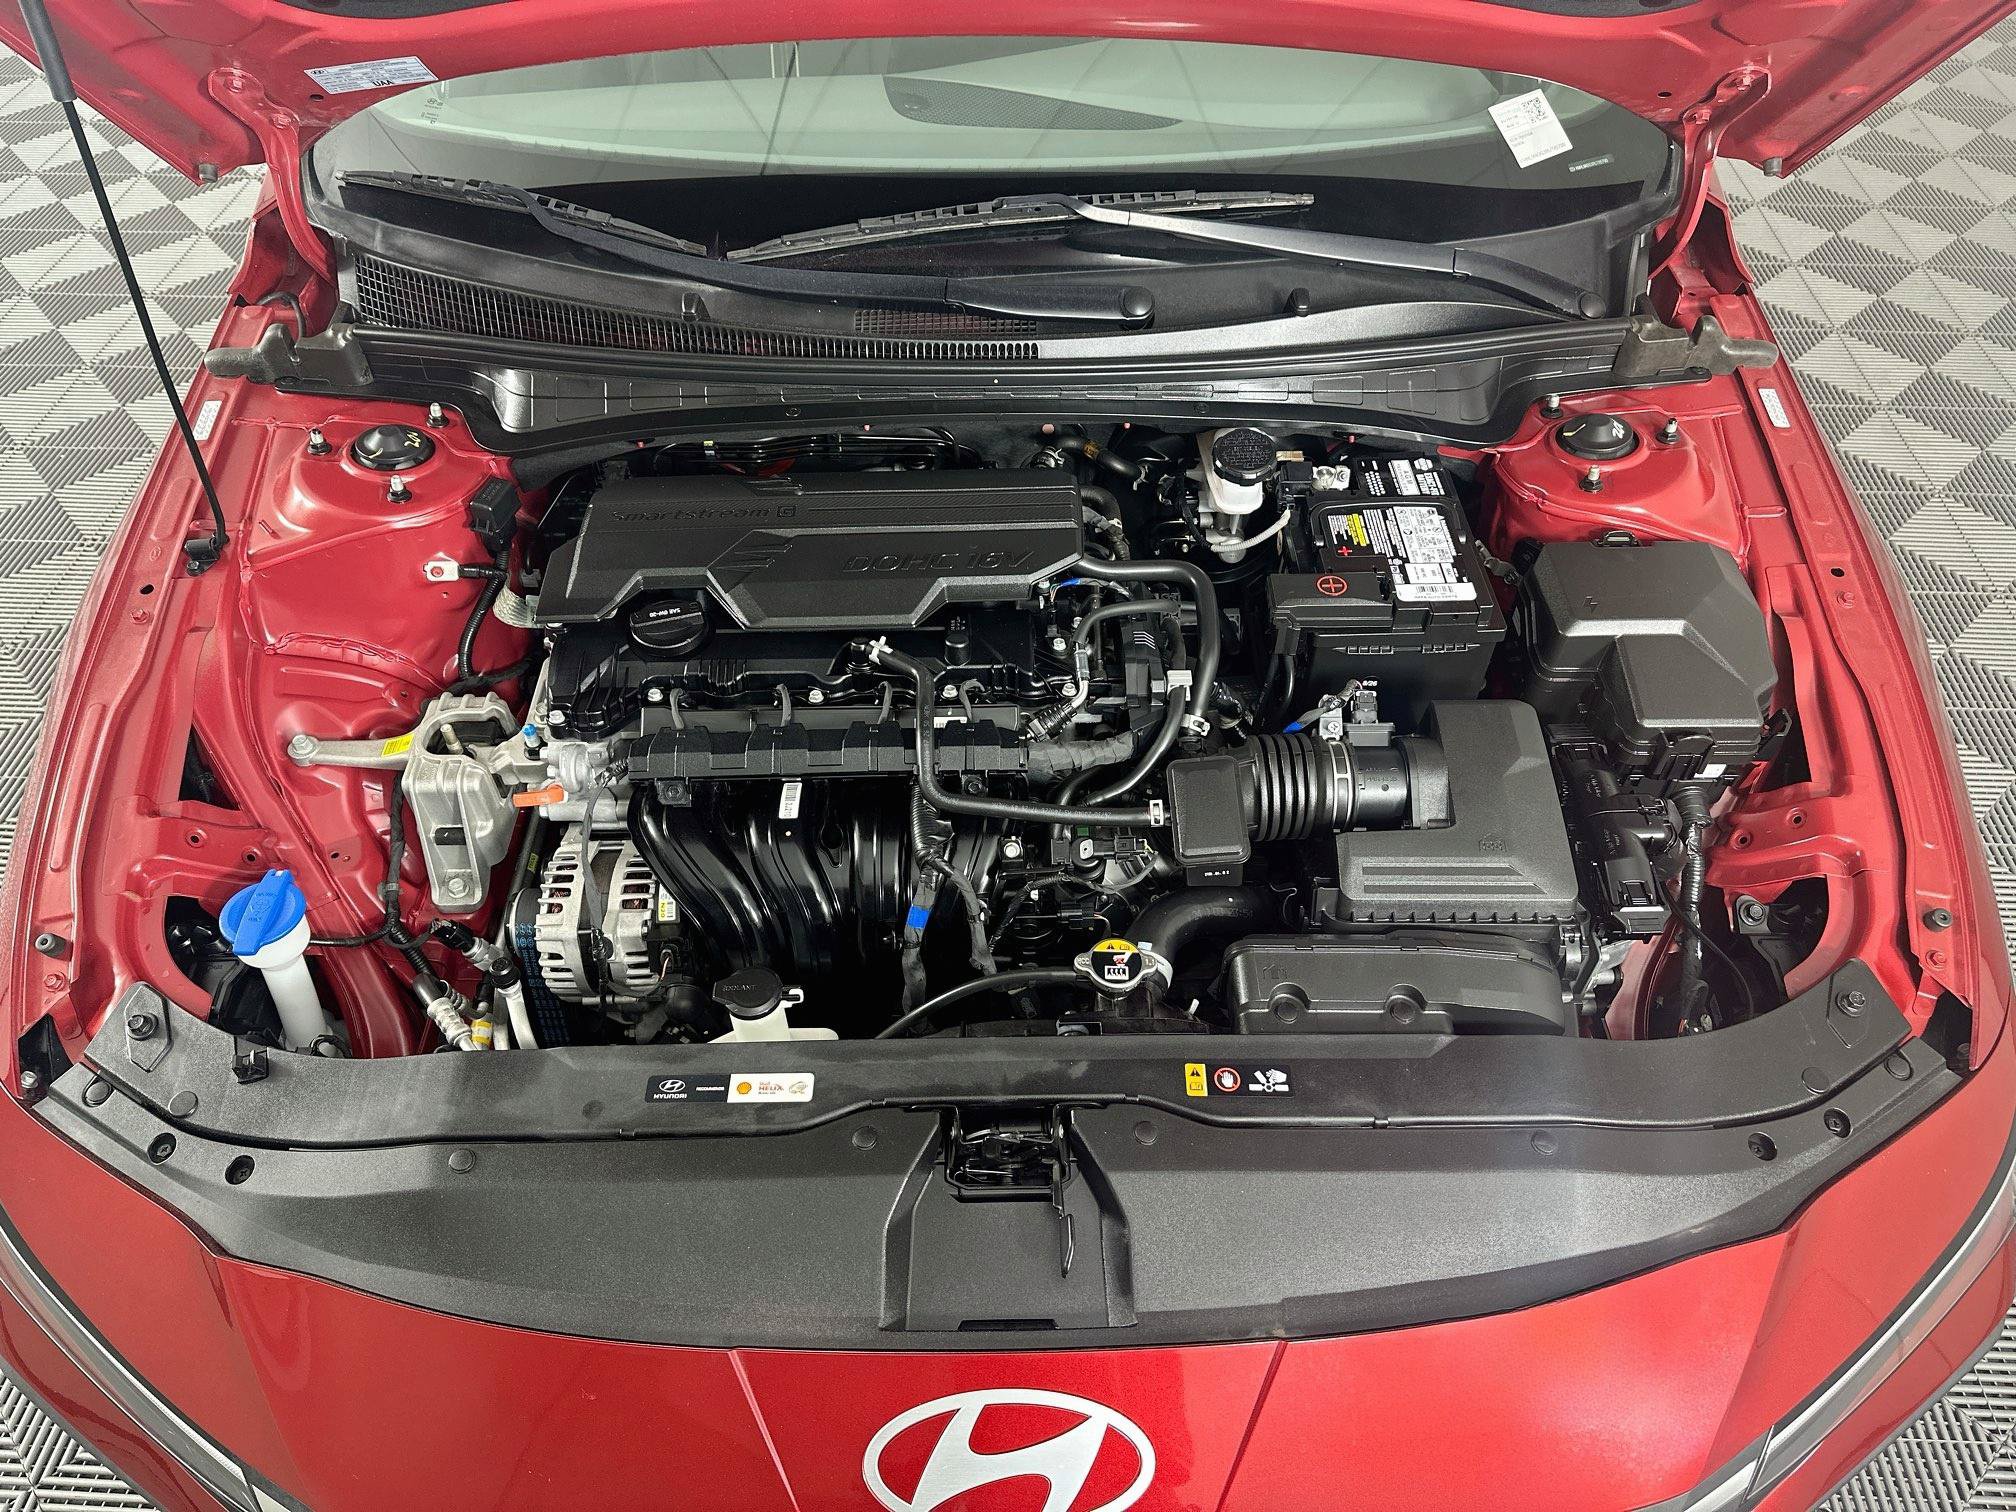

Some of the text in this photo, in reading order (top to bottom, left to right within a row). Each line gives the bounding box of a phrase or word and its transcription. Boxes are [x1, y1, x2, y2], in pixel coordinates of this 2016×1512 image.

[372, 79, 394, 87] UAA
[612, 508, 771, 521] Smartstream
[843, 551, 1035, 572] DOHC 16V
